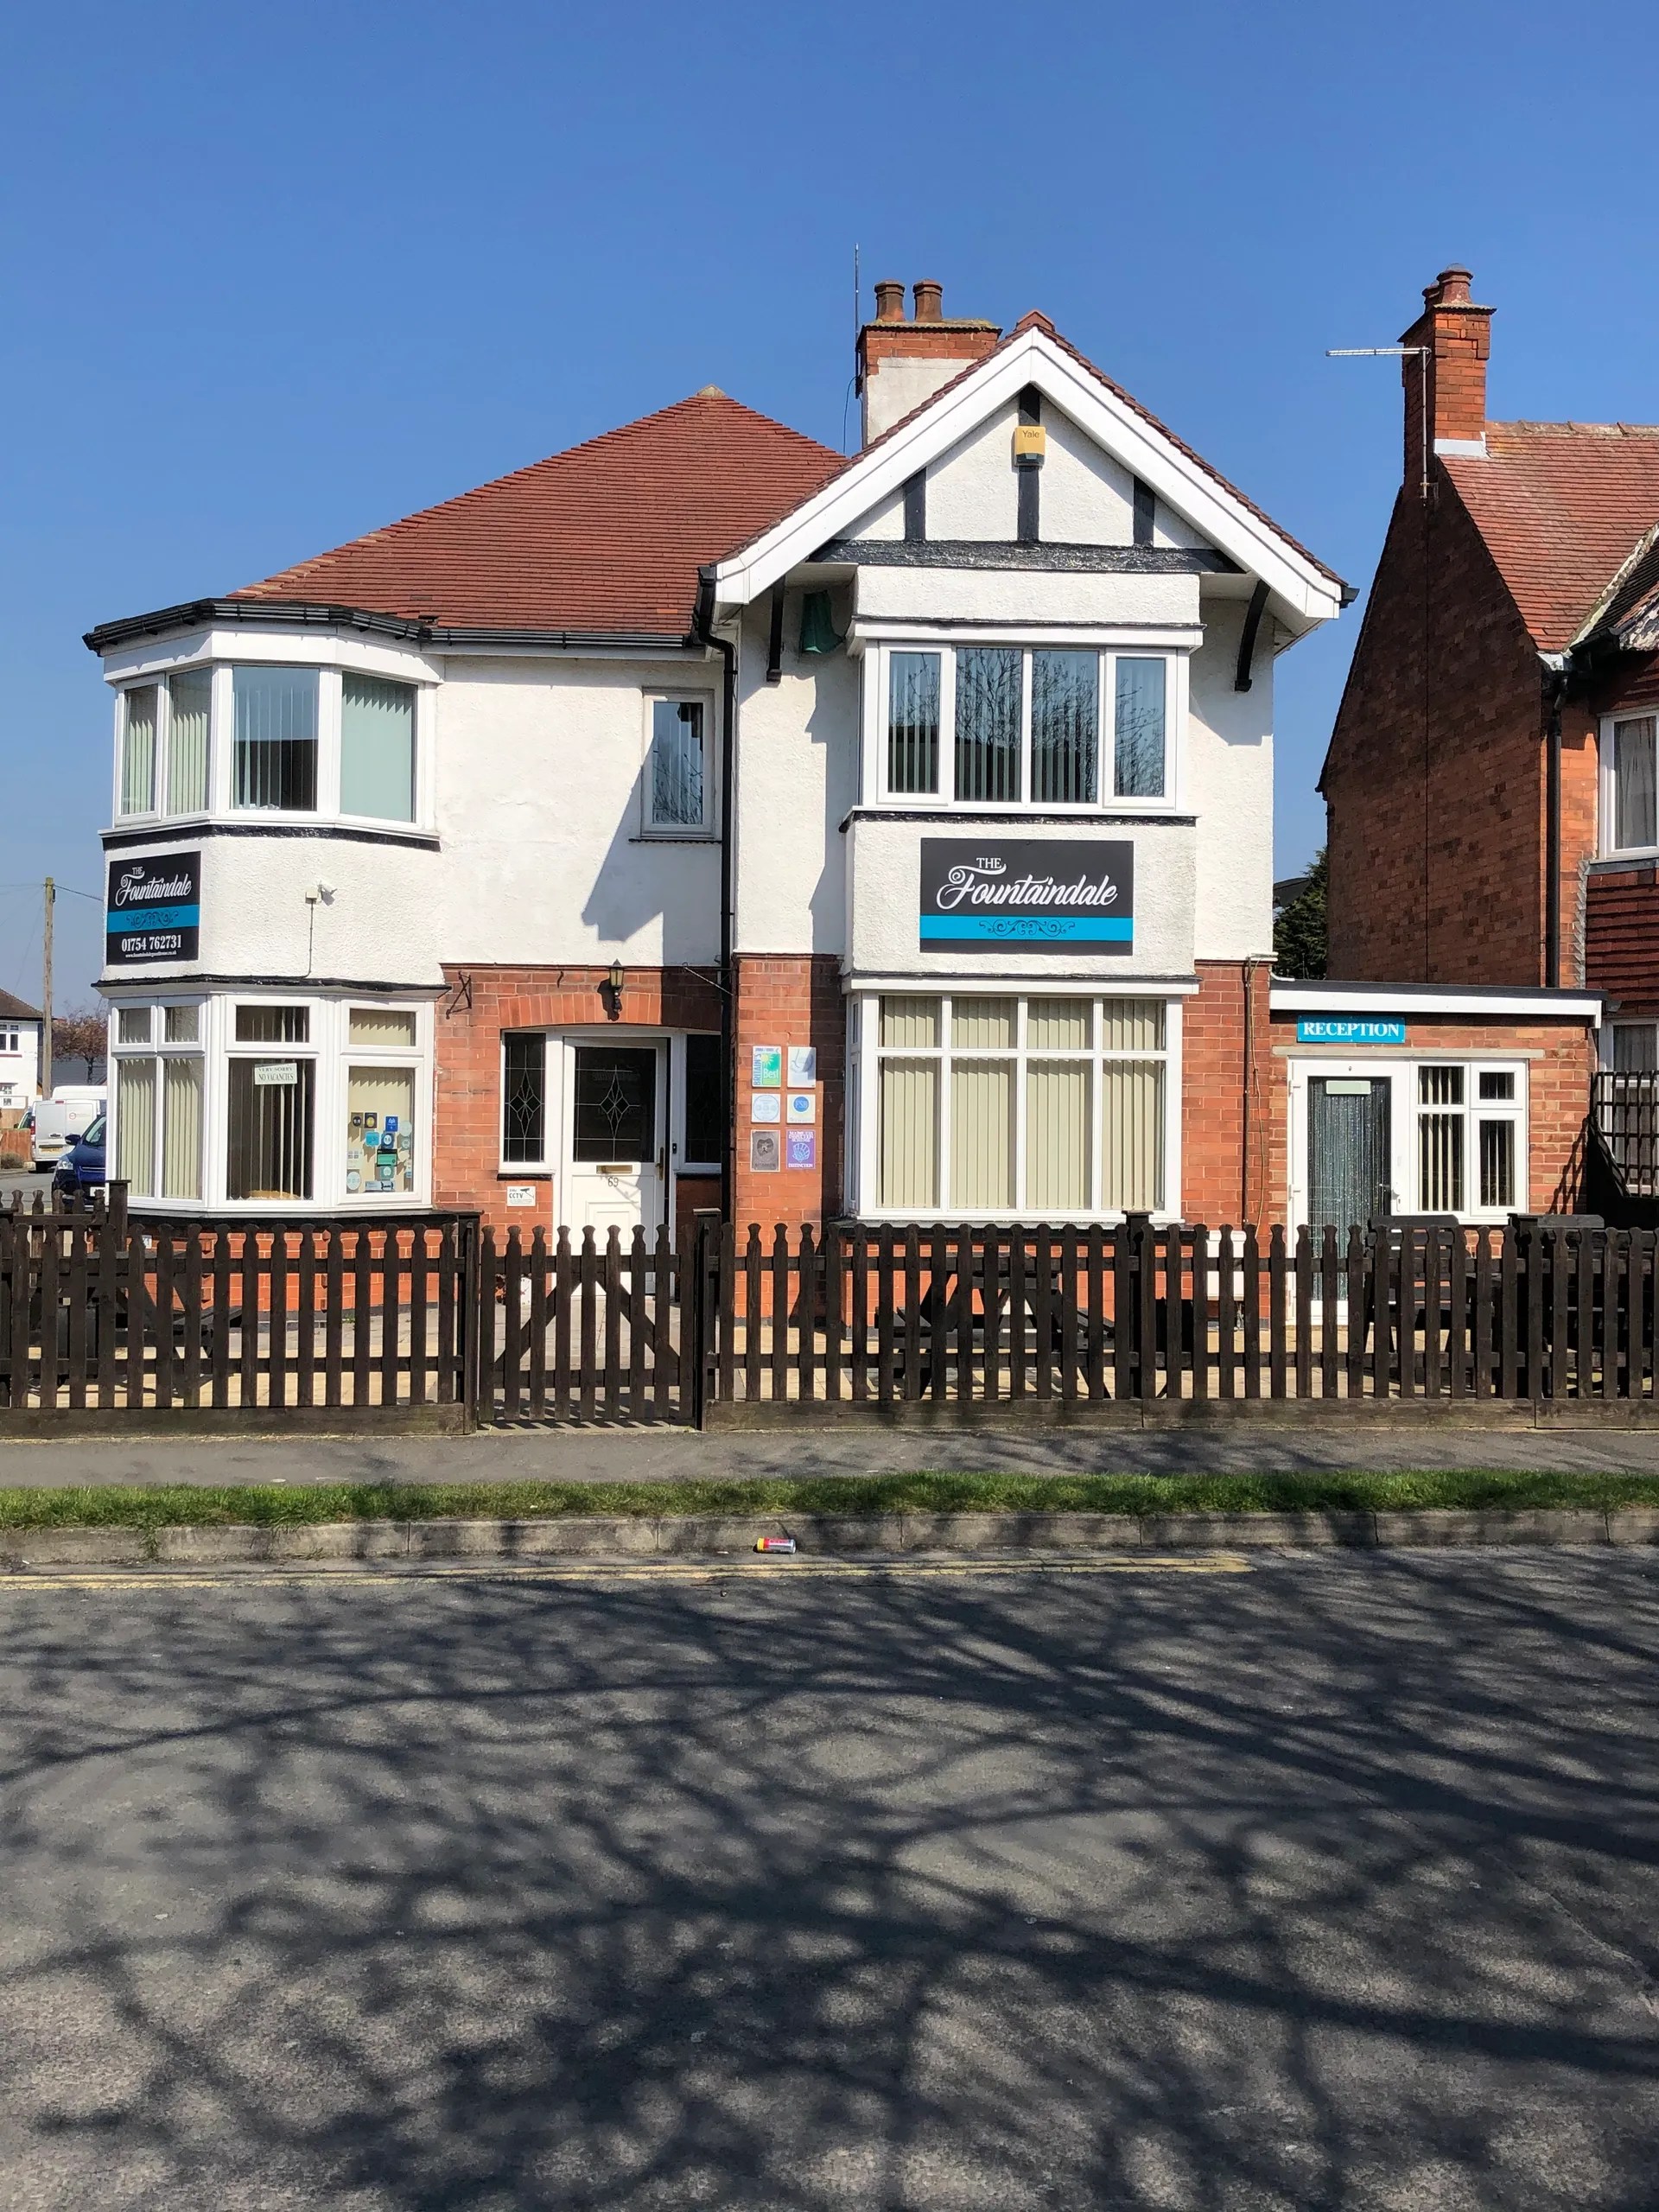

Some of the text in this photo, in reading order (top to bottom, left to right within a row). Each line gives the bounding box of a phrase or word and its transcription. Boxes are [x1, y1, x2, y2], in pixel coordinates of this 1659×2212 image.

[1022, 429, 1040, 438] Yale
[976, 857, 1002, 869] THE
[131, 866, 143, 875] THE
[115, 870, 192, 906] Fountaindale
[936, 864, 1119, 910] Fountaindale
[121, 934, 181, 952] 01754 762731
[1303, 1022, 1399, 1036] RECEPTION
[607, 1176, 619, 1188] 69
